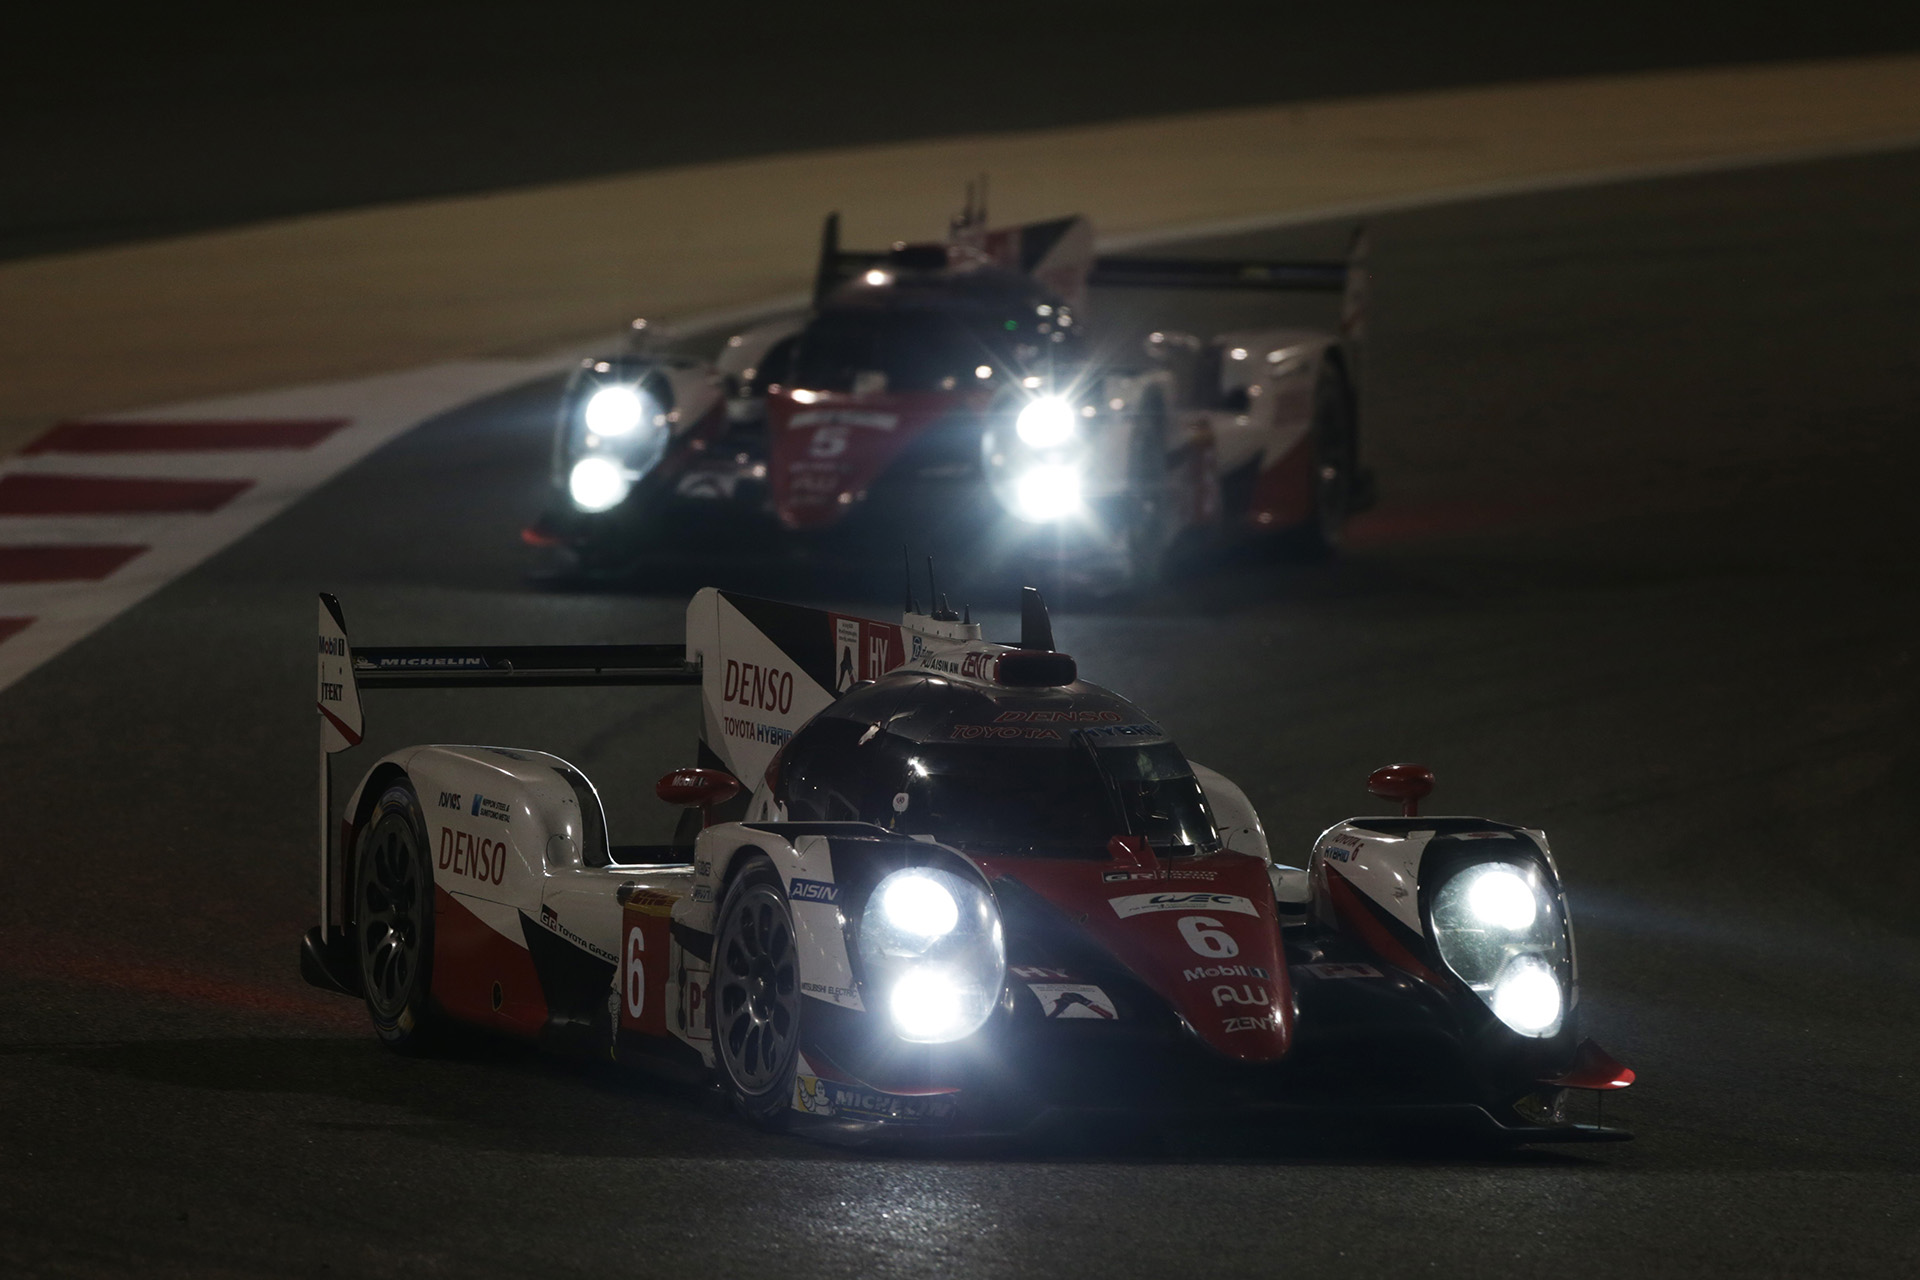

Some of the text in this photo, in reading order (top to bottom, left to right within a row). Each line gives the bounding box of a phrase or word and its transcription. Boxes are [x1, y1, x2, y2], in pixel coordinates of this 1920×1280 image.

[319, 635, 337, 655] Mobil
[380, 657, 481, 666] MICHELIN
[869, 635, 888, 679] HY
[931, 659, 948, 673] AISIN
[321, 682, 343, 703] JTEKT
[724, 659, 793, 715] DENSO
[994, 711, 1122, 723] DENSO
[724, 716, 755, 740] TOYOTA
[950, 725, 1062, 740] TOYOTA
[672, 776, 696, 787] Mobil
[439, 827, 506, 886] DENSO
[1351, 843, 1364, 861] 6
[792, 883, 838, 900] AISIN
[541, 911, 557, 931] GR
[558, 923, 587, 948] TOYOTA
[1177, 916, 1239, 959] 6
[627, 926, 645, 1018] 6
[1183, 965, 1248, 982] Mobil
[1222, 1016, 1276, 1033] ZENT
